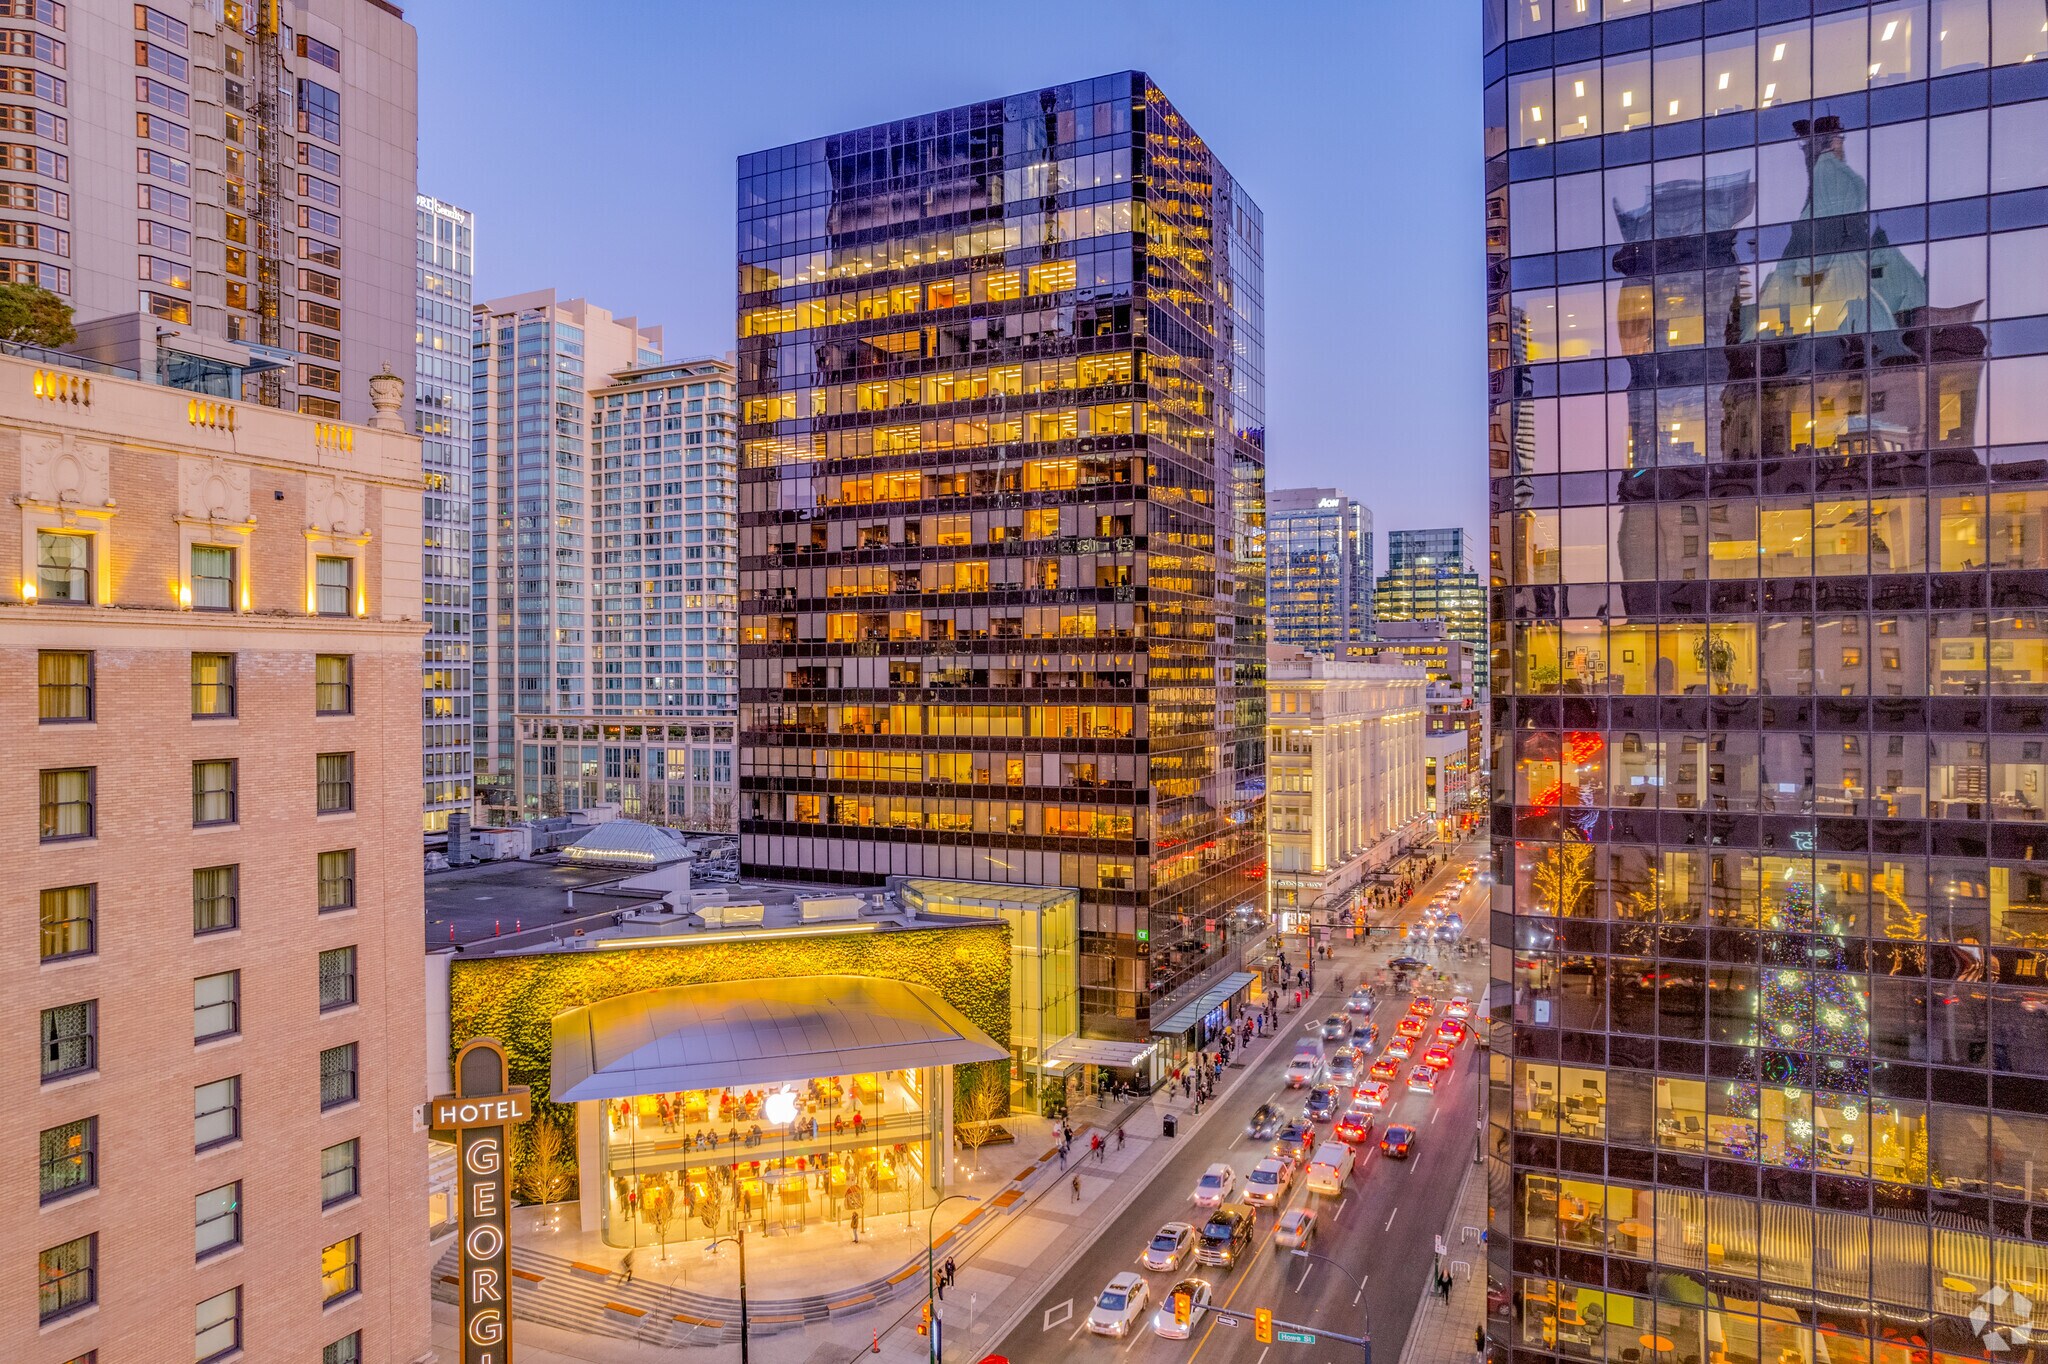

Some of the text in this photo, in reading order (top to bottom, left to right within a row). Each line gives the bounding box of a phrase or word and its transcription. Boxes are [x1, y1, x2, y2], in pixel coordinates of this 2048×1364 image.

[441, 1100, 523, 1124] HOTEL
[466, 1138, 504, 1364] GEORG
[1281, 1333, 1301, 1341] Howe
